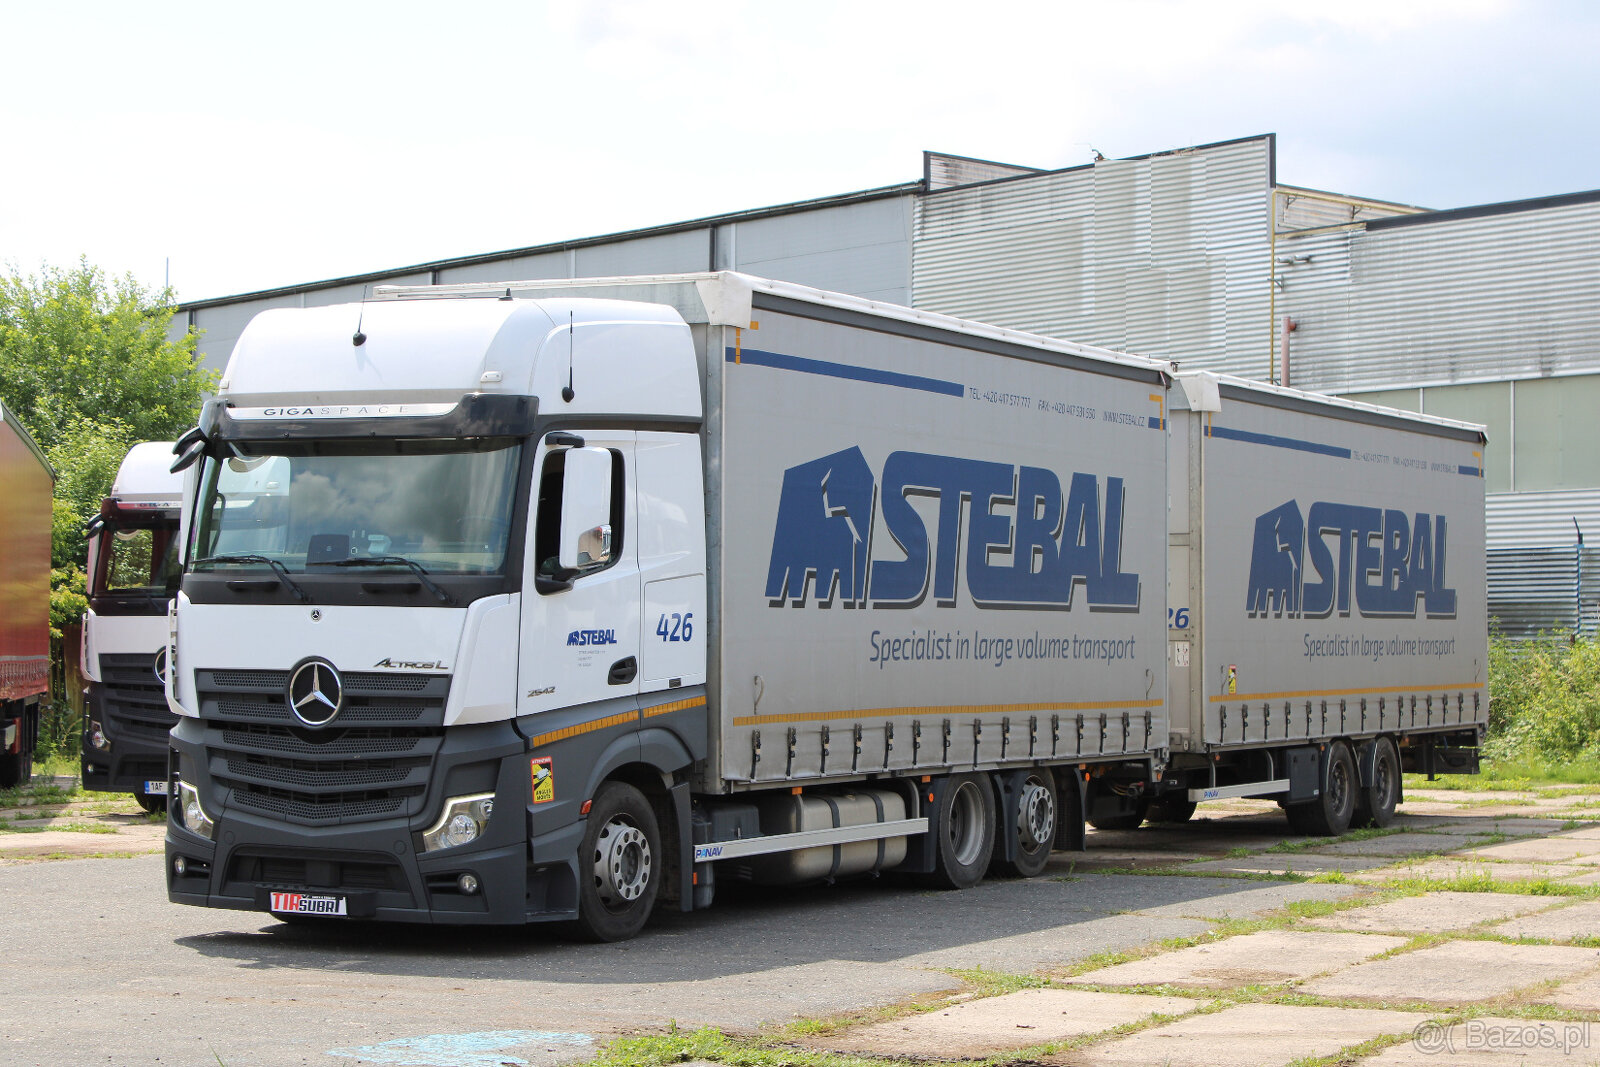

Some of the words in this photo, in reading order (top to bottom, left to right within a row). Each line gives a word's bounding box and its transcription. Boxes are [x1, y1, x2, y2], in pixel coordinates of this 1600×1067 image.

[1020, 396, 1031, 408] 777
[869, 450, 1142, 613] STEBAL
[1302, 501, 1457, 620] STEBAL
[579, 629, 617, 646] STEBAL
[656, 612, 693, 642] 426
[869, 630, 952, 669] Specialist
[955, 630, 970, 659] in
[973, 630, 1013, 668] large
[1017, 630, 1070, 659] volume
[1073, 634, 1136, 666] transport
[1303, 633, 1349, 662] Specialist
[1351, 634, 1360, 656] in
[1361, 634, 1384, 662] large
[1385, 634, 1417, 656] volume
[1418, 636, 1456, 660] transport
[435, 660, 449, 669] L
[696, 847, 723, 859] PANAV
